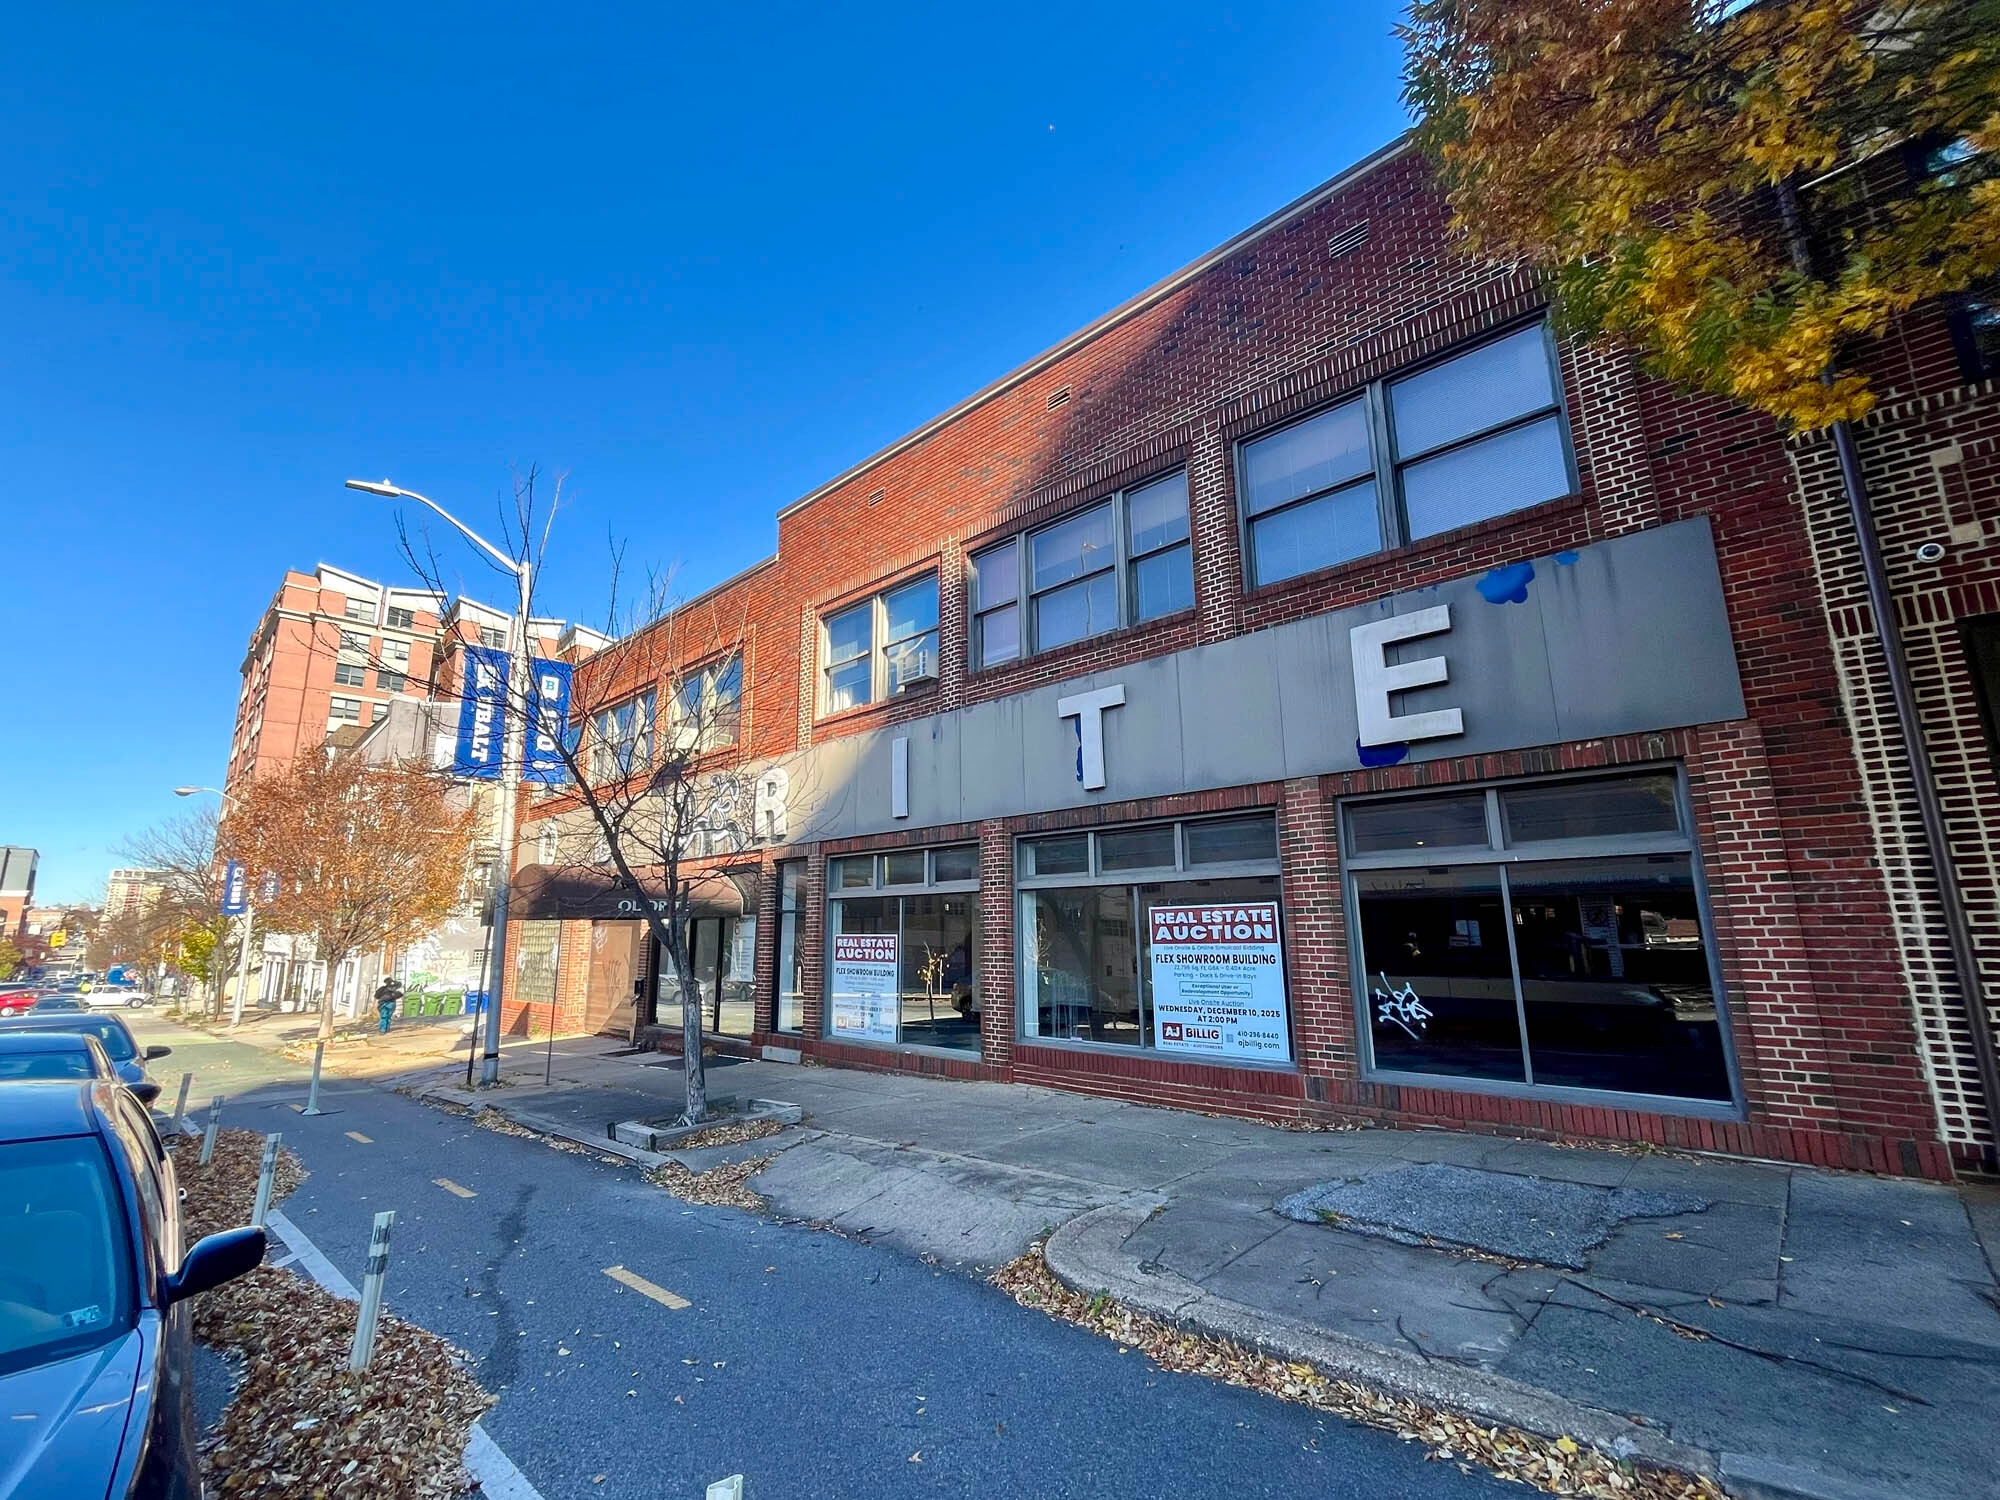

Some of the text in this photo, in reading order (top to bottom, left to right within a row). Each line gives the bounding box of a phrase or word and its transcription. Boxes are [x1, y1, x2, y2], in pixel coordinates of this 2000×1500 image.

[1154, 909, 1272, 924] REAL ESTATE
[1155, 924, 1273, 941] AUCTION
[836, 938, 895, 948] REAL ESTATE
[836, 948, 895, 960] AUCTION
[1155, 954, 1276, 964] FLEX SHOWROOM BUILDING
[1207, 1007, 1247, 1016] DECEMBER
[1261, 1010, 1280, 1018] 2025
[1185, 1027, 1220, 1040] BILLIG
